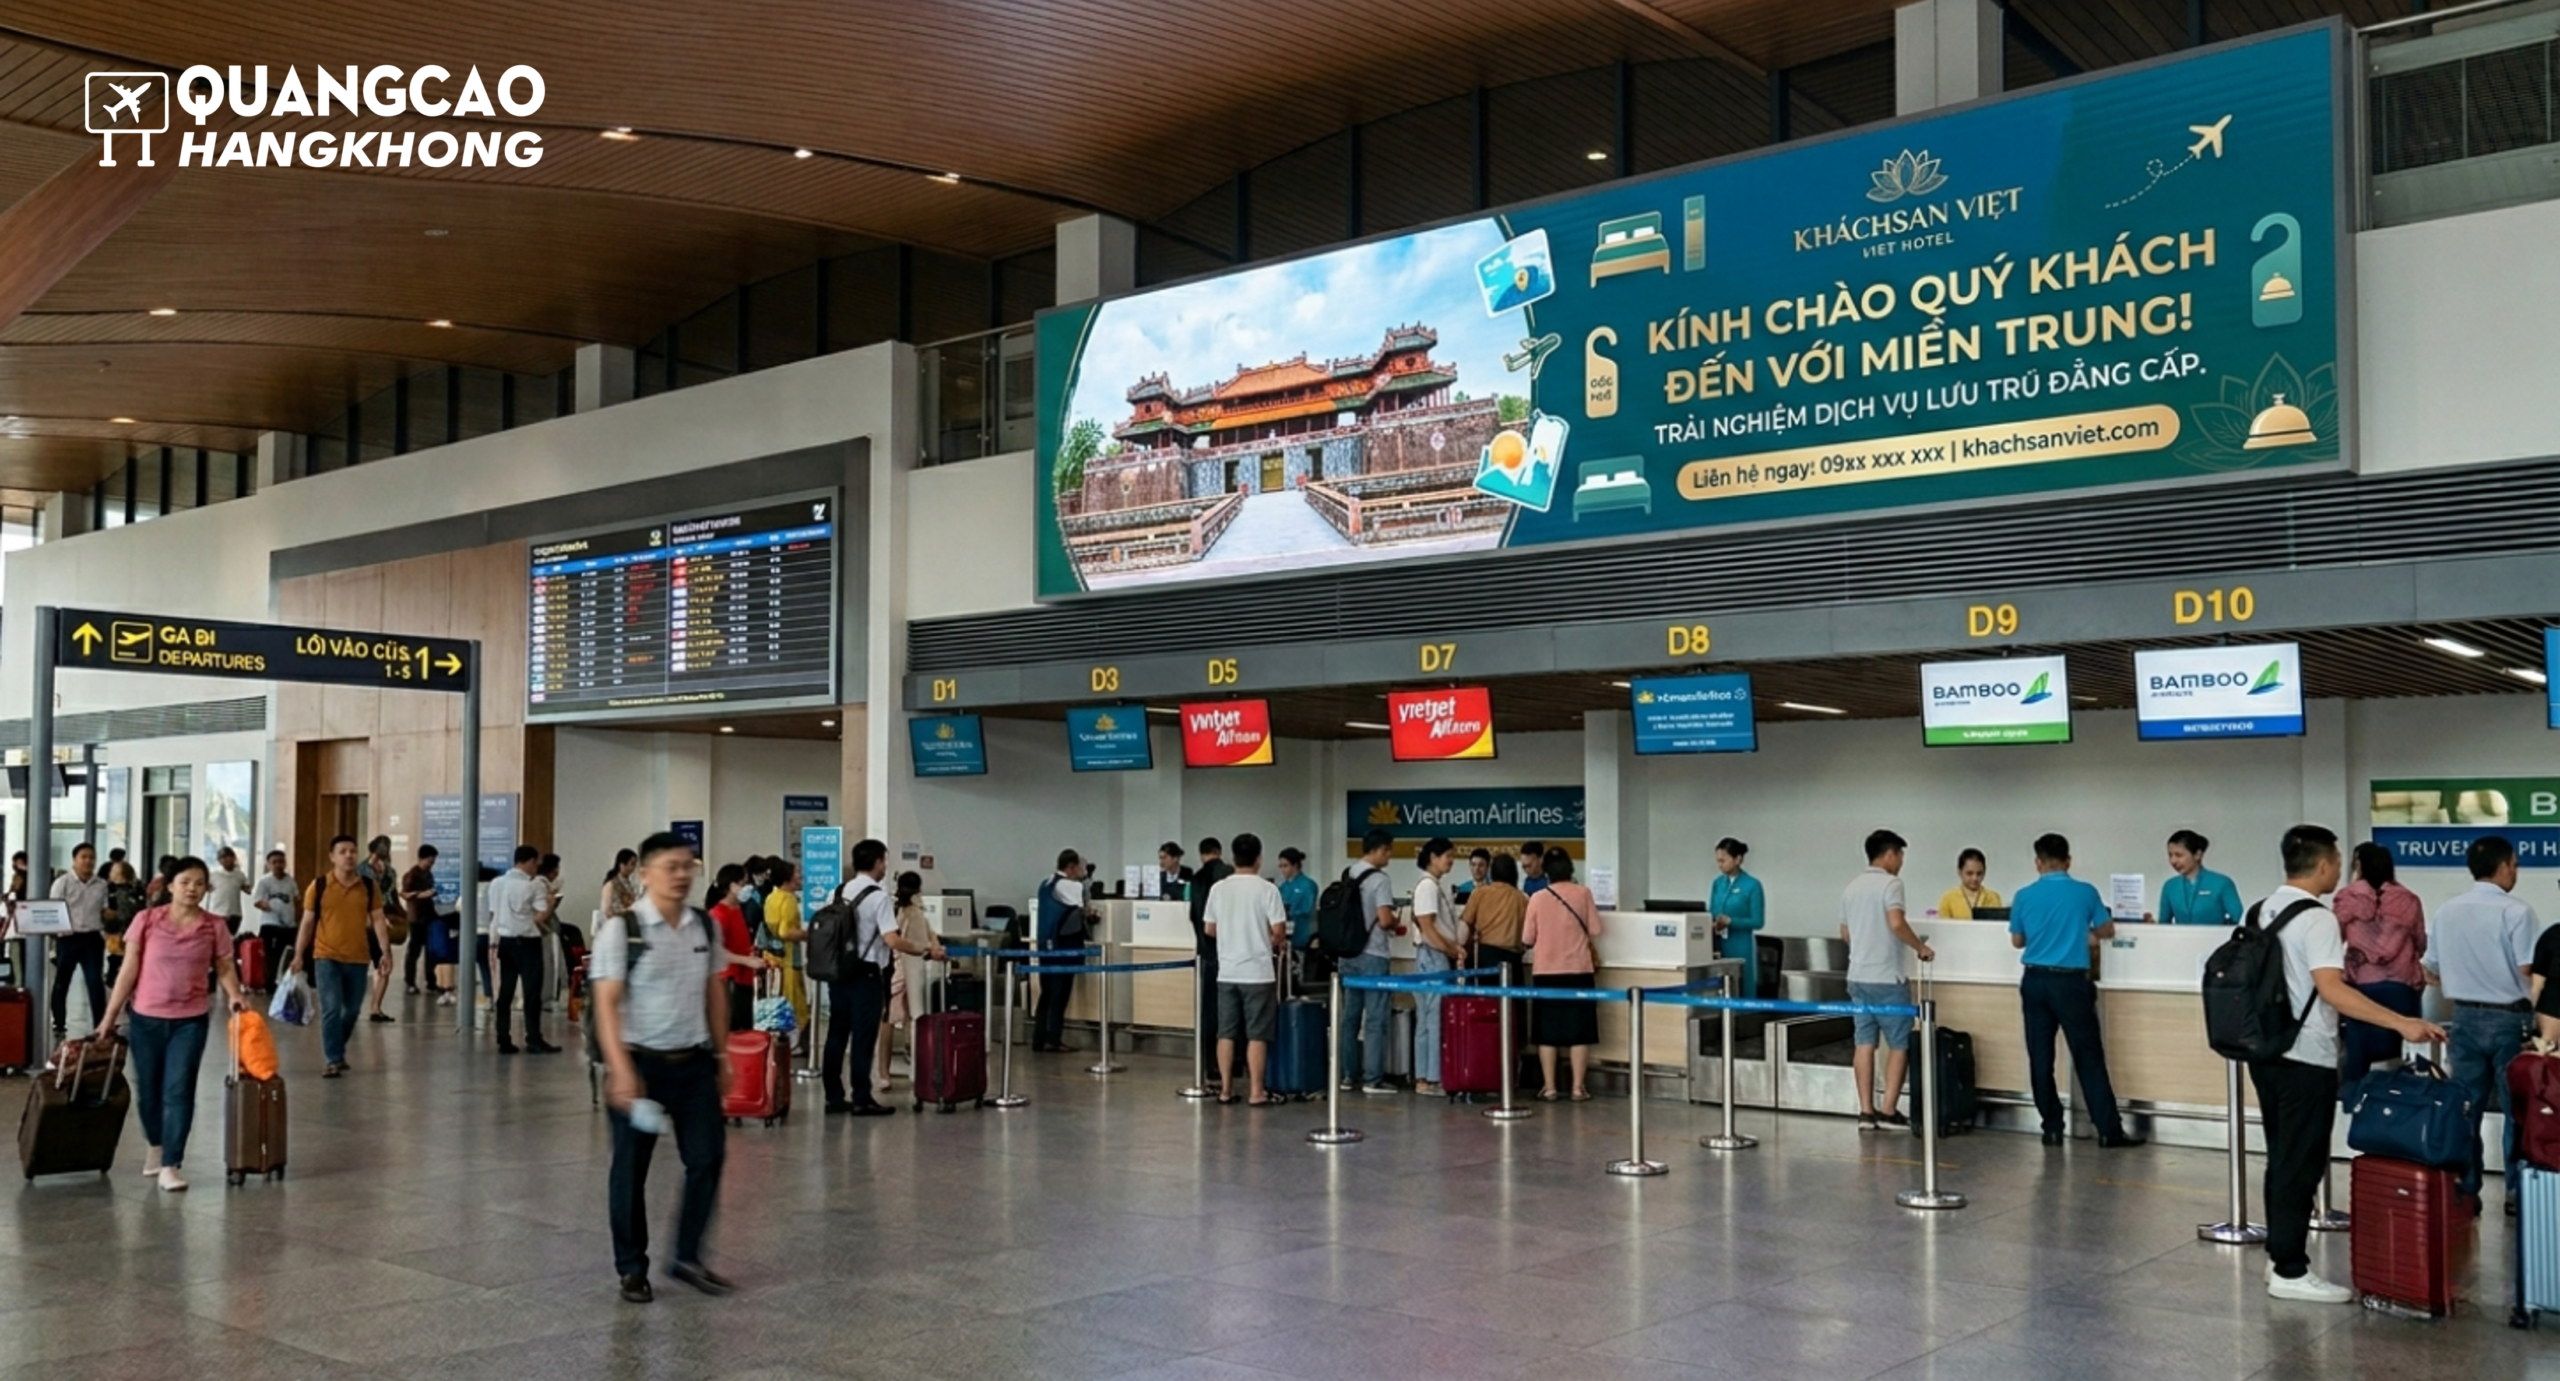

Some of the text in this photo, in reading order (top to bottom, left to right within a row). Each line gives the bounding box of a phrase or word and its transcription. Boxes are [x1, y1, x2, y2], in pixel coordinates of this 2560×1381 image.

[1793, 187, 2023, 251] KHÁCHSAN VIỆT
[1901, 232, 1955, 252] HOTEL
[1648, 228, 2216, 354] KÍNH CHÀO QUÝ KHÁCH
[1664, 293, 2193, 404] ĐẾN VỚI MIỀN TRUNG!
[1713, 403, 1807, 438] NGHIỆM
[1815, 396, 1875, 426] DỊCH
[1882, 390, 1918, 420] VỤ
[1926, 381, 1978, 411] LƯU
[2140, 347, 2207, 382] CẤP.
[1962, 420, 2159, 458] khachsanviet.com
[1968, 603, 2019, 637] D9
[2174, 586, 2255, 625] D10
[160, 626, 191, 645] GA
[1668, 624, 1711, 656] D8
[159, 649, 266, 671] DEPARTURES
[1208, 659, 1239, 685] D5
[1421, 643, 1456, 672] D7
[932, 679, 957, 702] D1
[1091, 667, 1120, 692] D3
[1933, 682, 2022, 700] BAMBOO
[2149, 671, 2249, 691] BAMBOO
